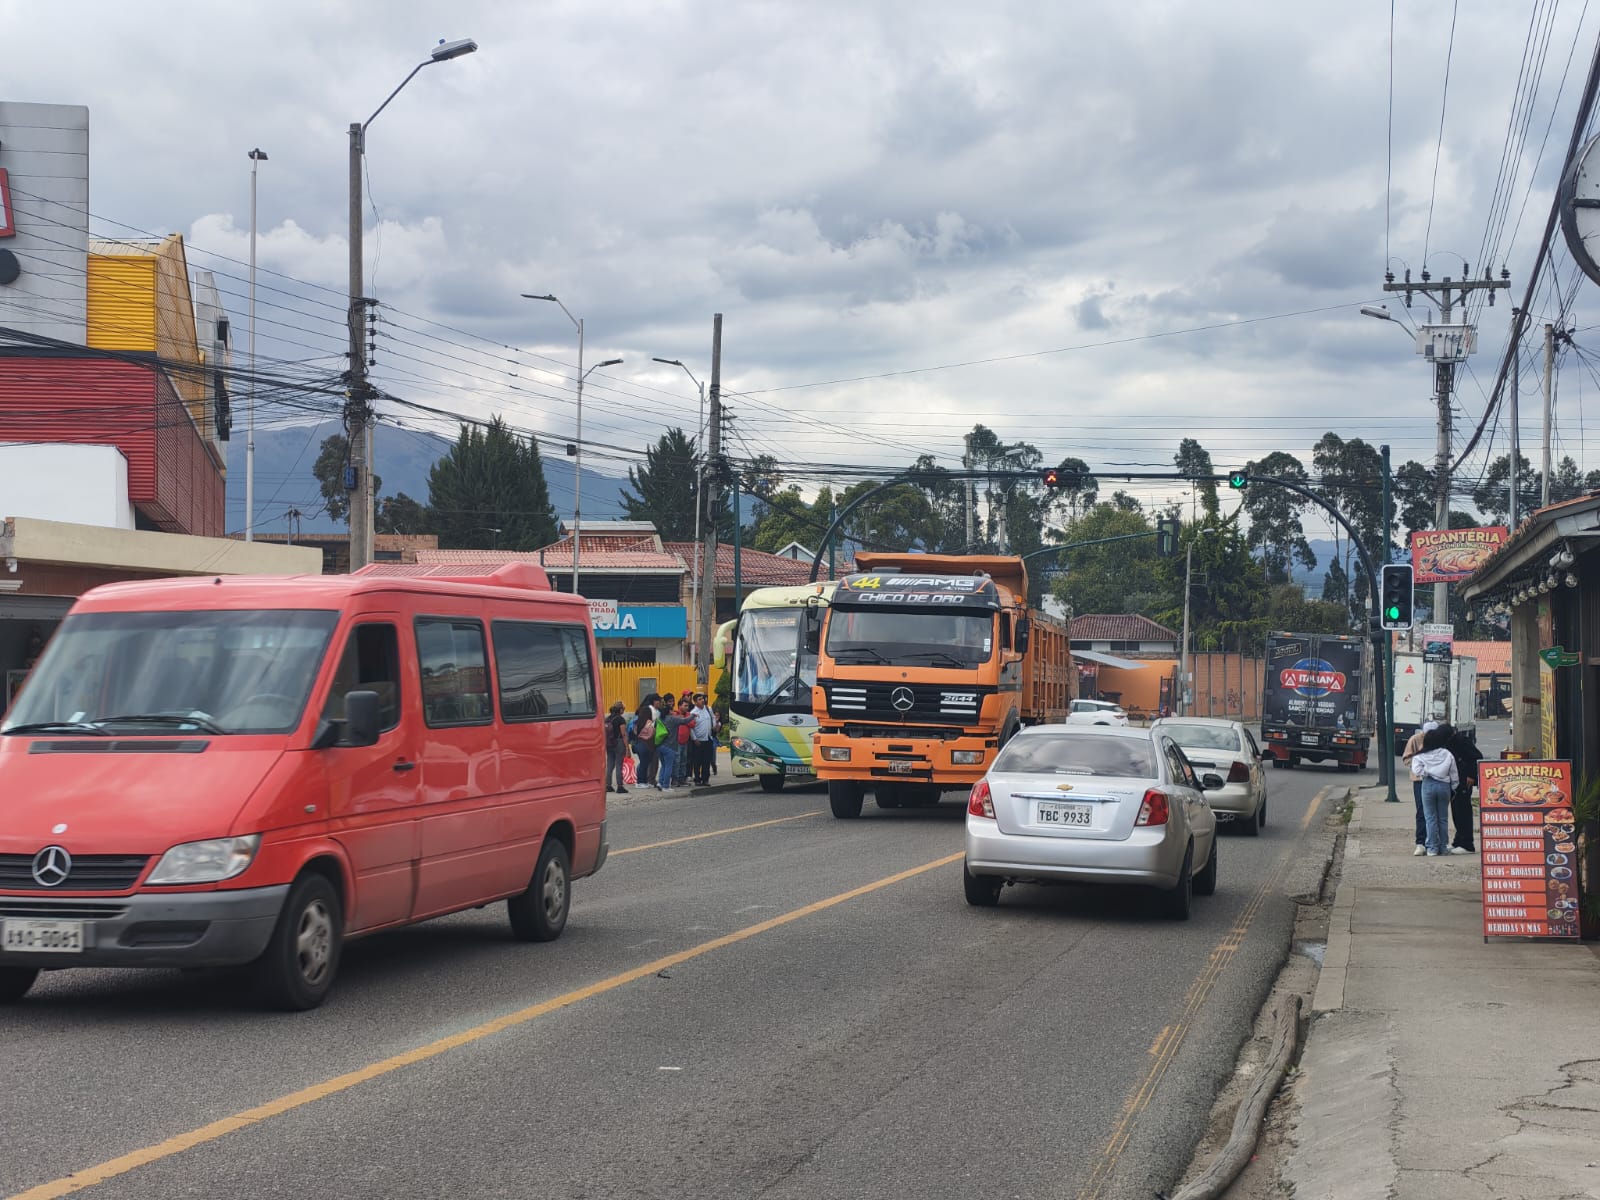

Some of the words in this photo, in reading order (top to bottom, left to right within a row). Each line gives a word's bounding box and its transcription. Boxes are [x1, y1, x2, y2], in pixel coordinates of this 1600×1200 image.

[852, 577, 881, 589] 44
[858, 593, 904, 602] CHICO
[906, 594, 930, 603] DE
[931, 595, 965, 604] ORO
[1040, 809, 1059, 821] TBC
[1063, 811, 1090, 824] 9933
[1484, 813, 1508, 822] POLLO
[1510, 813, 1534, 822] ASADO
[1485, 840, 1517, 849] PESCADO
[1486, 853, 1520, 863] CHULETA
[1486, 867, 1505, 876] SECOS
[1510, 867, 1543, 876] BROASTER
[1487, 880, 1521, 889] BOLONES
[1487, 894, 1525, 903] DESAYUNOS
[1487, 908, 1528, 917] ALMUERZOS
[1487, 923, 1519, 933] BEBIDAS
[1520, 923, 1525, 933] Y
